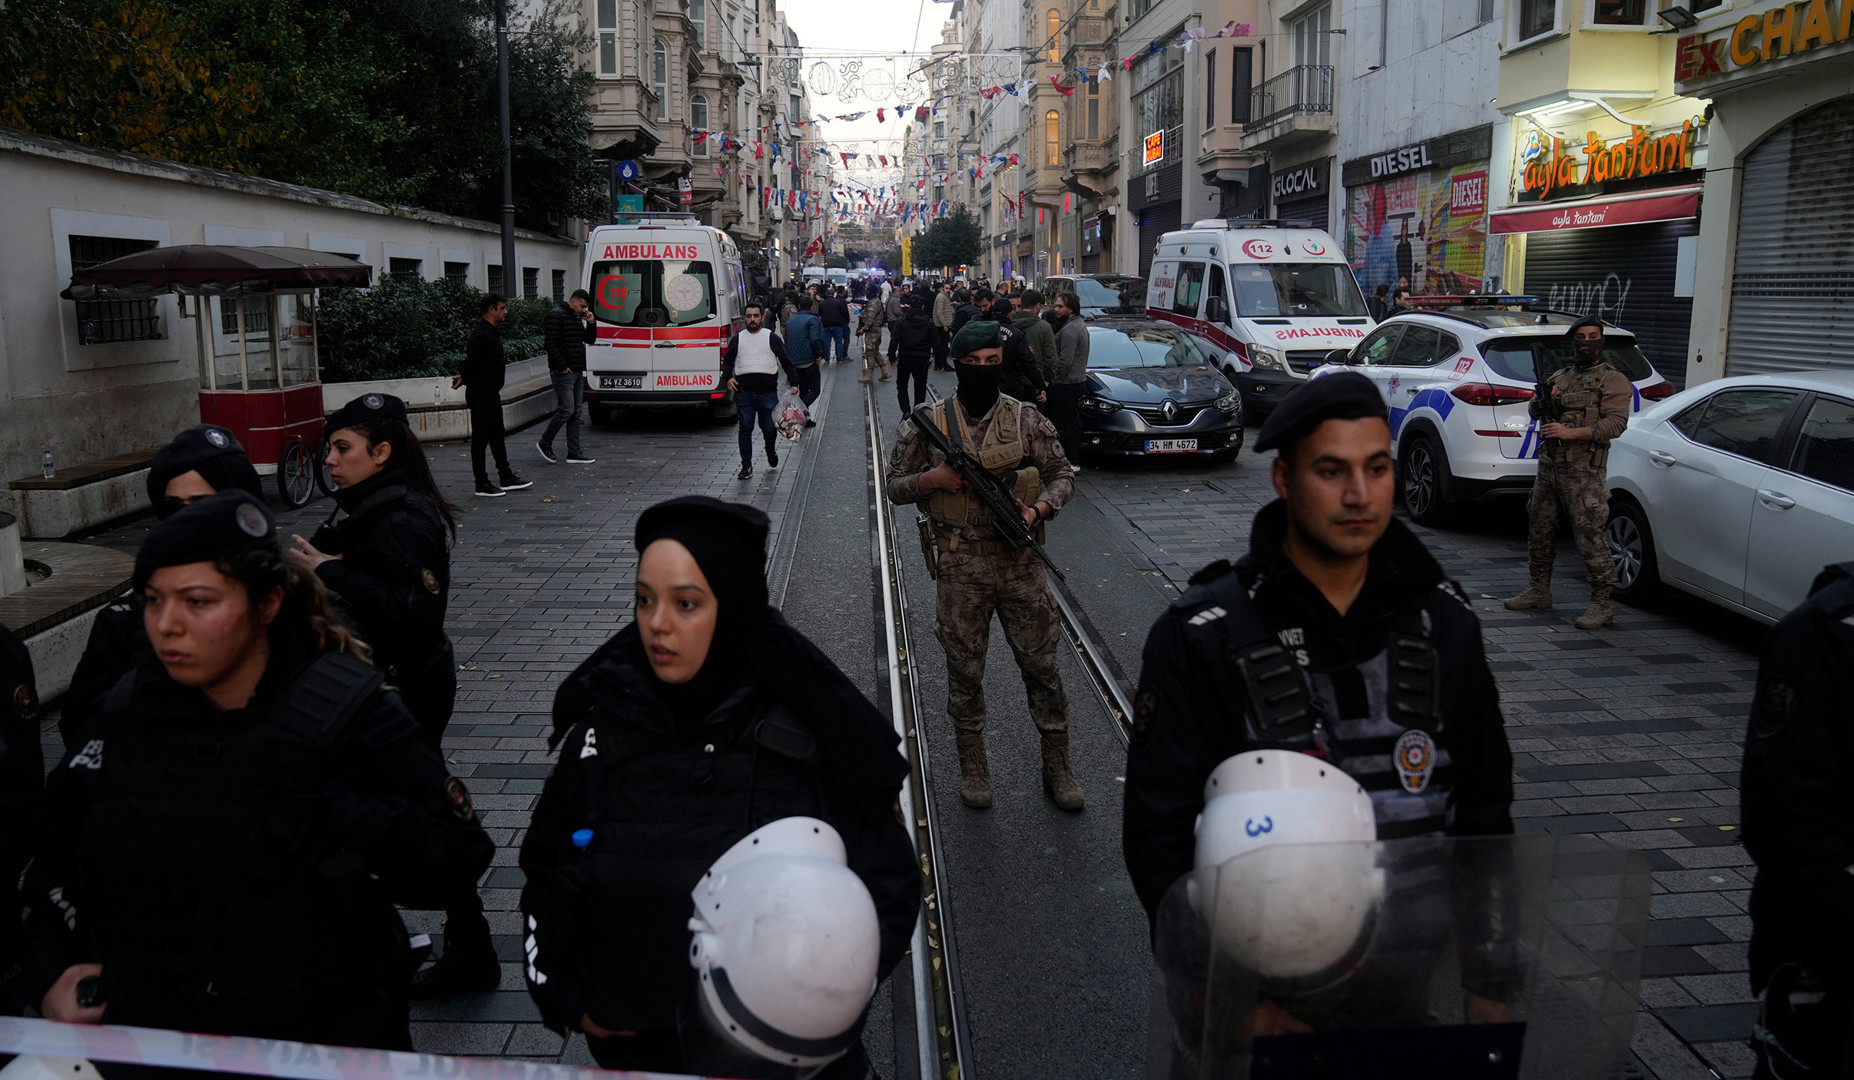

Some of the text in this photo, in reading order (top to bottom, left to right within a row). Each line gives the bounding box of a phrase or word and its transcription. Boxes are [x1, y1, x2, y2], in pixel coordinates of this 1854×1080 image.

[1371, 145, 1432, 178] DIESEL
[1524, 120, 1690, 200] ayla tantuni
[1274, 167, 1317, 197] GLOCAL
[1452, 178, 1482, 208] DIESEL
[1552, 206, 1608, 228] ayla tantuni
[603, 245, 698, 259] AMBULANS
[1250, 245, 1273, 253] 112
[609, 287, 628, 298] 112
[1457, 360, 1470, 372] 112
[614, 378, 622, 386] VZ
[656, 375, 713, 386] AMBULANS
[1150, 440, 1196, 449] 34 HM 4672
[1245, 815, 1273, 837] 3
